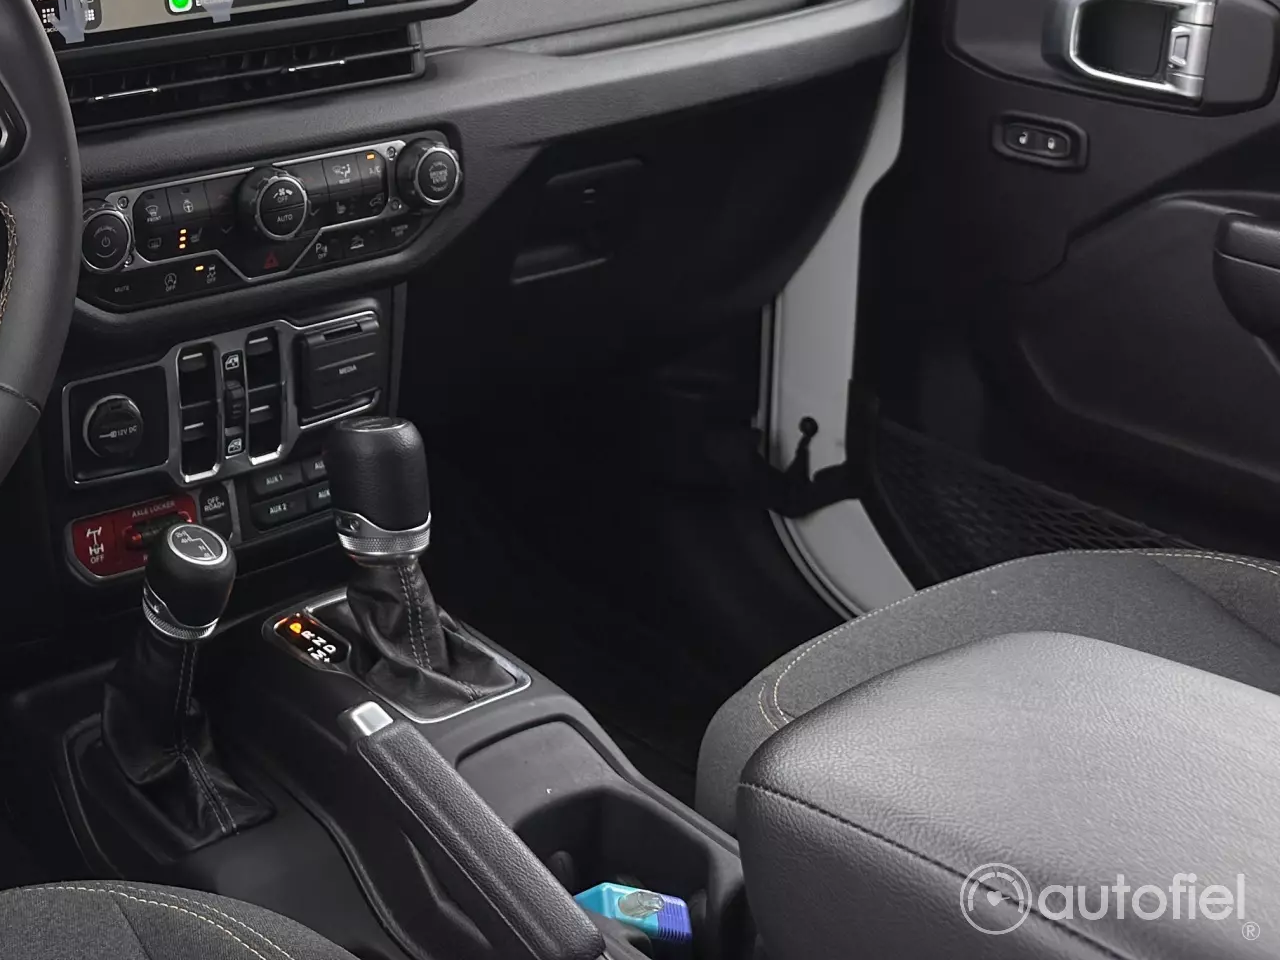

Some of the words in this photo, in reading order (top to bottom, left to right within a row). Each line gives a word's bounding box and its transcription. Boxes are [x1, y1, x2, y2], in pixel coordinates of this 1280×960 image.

[276, 195, 289, 204] OFF
[276, 213, 293, 223] AUTO
[338, 364, 357, 375] MEDIA
[117, 428, 128, 436] 12V
[128, 425, 137, 434] DC
[266, 475, 279, 485] AUX
[207, 496, 220, 505] OFF
[132, 508, 149, 518] AXLE
[149, 500, 176, 514] LOCKER
[269, 505, 281, 515] AUX
[90, 555, 105, 565] OFF
[301, 630, 315, 640] R
[312, 636, 327, 647] N
[322, 644, 337, 654] D
[310, 649, 327, 660] M
